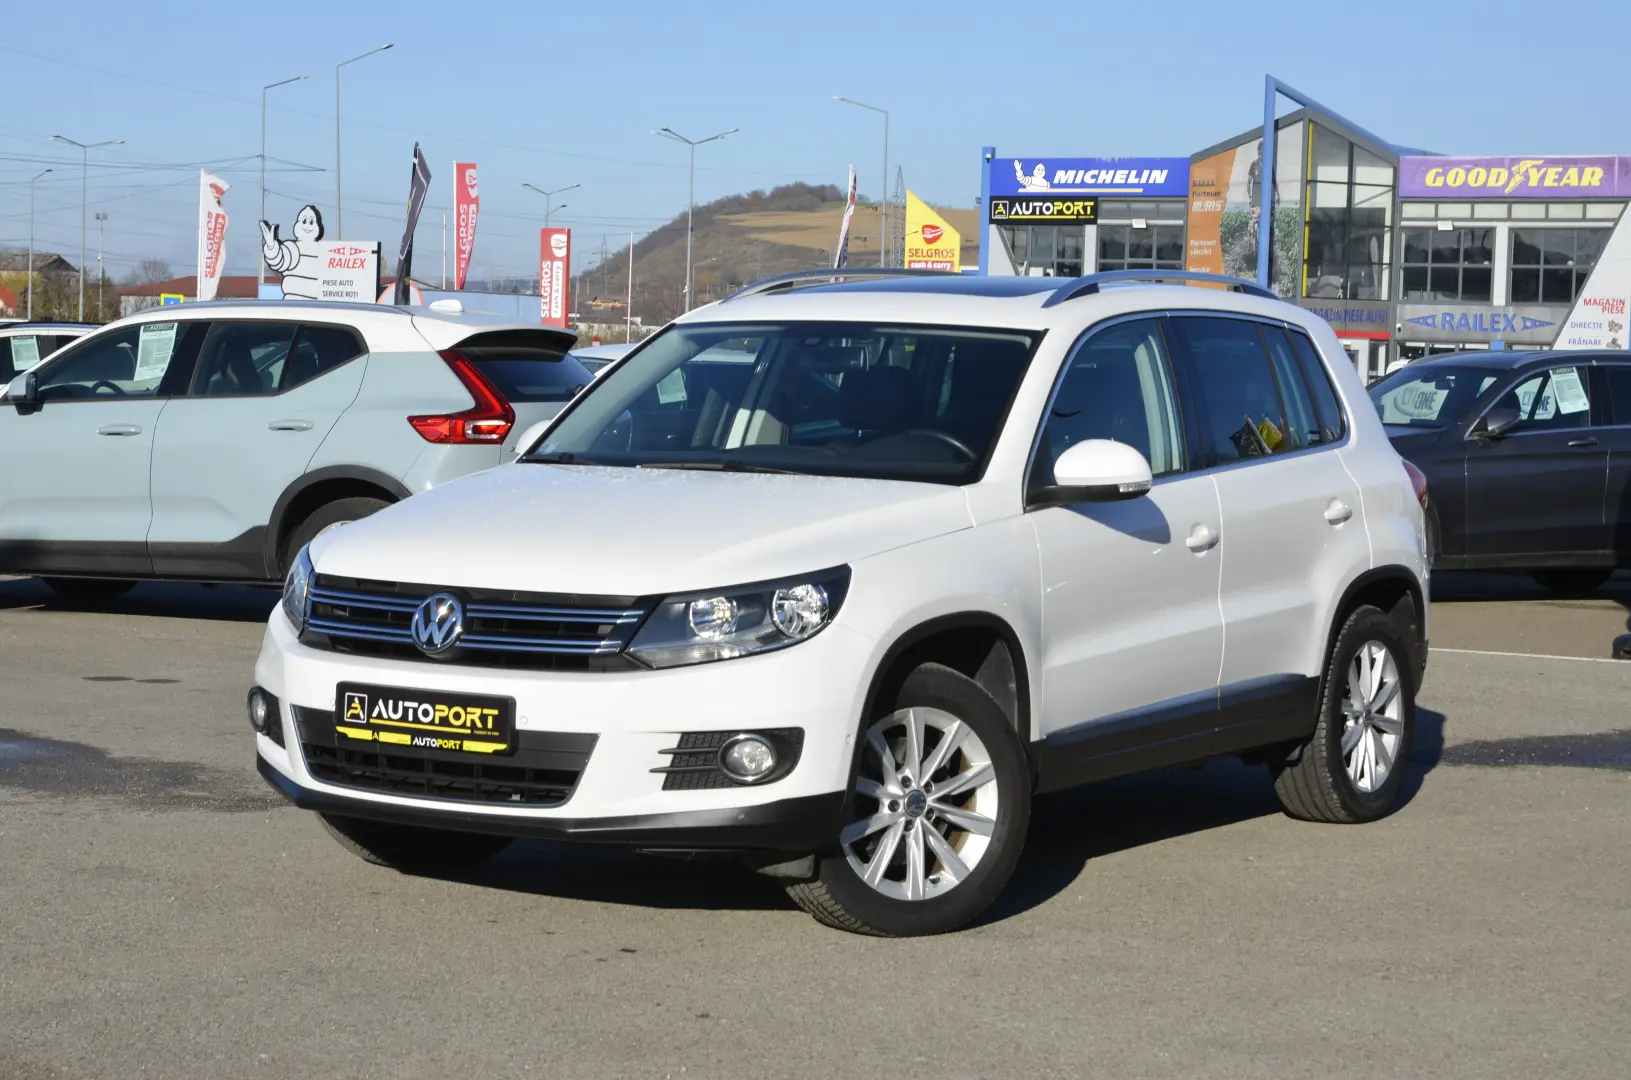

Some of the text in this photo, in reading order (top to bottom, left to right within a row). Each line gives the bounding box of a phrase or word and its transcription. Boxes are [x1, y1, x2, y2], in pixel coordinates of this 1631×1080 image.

[1053, 169, 1168, 185] MICHELIN
[1010, 202, 1095, 216] AUTOPORT
[205, 211, 214, 278] SELGROS
[908, 247, 955, 259] SELGROS
[328, 257, 367, 269] RAILEX
[910, 259, 952, 271] cash & carry
[554, 265, 562, 286] carry
[322, 279, 354, 287] PIESE AUTO
[541, 260, 551, 318] SELGROS
[322, 290, 344, 298] SERVICE
[1583, 298, 1625, 307] MAGAZIN
[1602, 305, 1625, 314] PIESE
[1343, 308, 1364, 323] PIESE
[1365, 308, 1388, 324] AUTO
[1440, 312, 1516, 333] RAILEX
[371, 698, 499, 729] AUTOPORT
[412, 736, 461, 750] AUTOPORT
